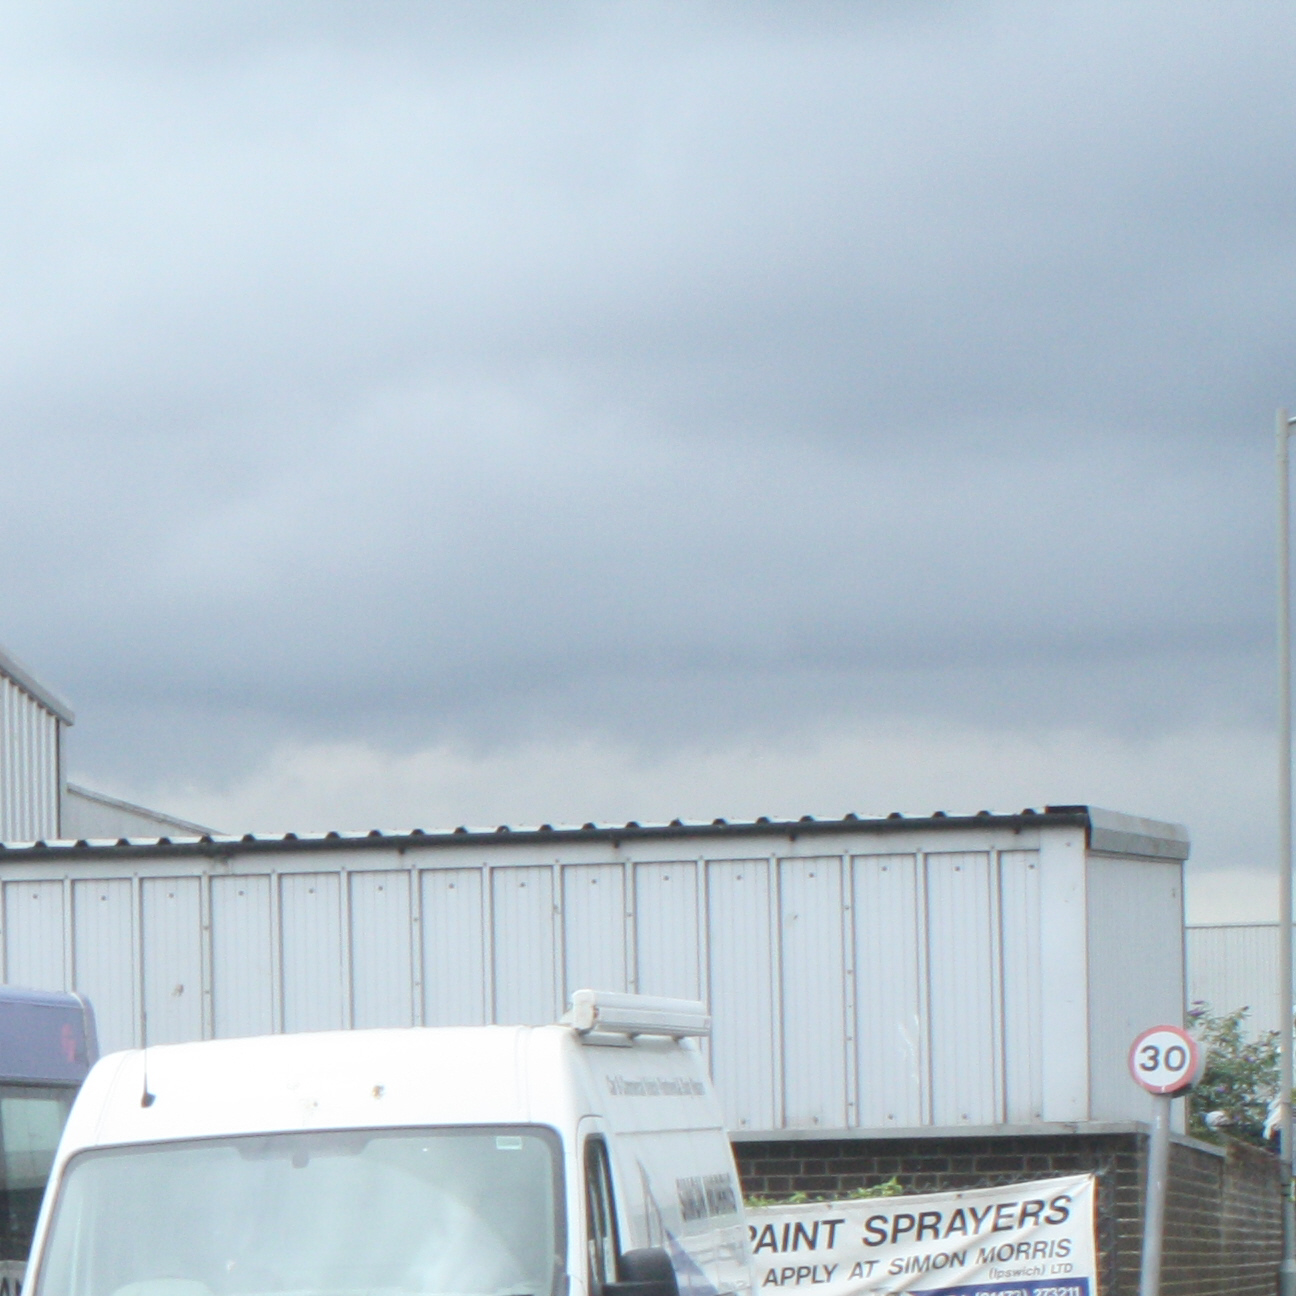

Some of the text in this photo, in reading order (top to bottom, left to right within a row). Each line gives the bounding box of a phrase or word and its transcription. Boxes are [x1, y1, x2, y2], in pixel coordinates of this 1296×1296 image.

[1139, 1044, 1187, 1072] 30
[861, 1194, 1073, 1248] SPRAYERS
[762, 1238, 1072, 1288] APPLY AT SIMON MORRIS
[988, 1261, 1074, 1282] (Ipswich) LTD
